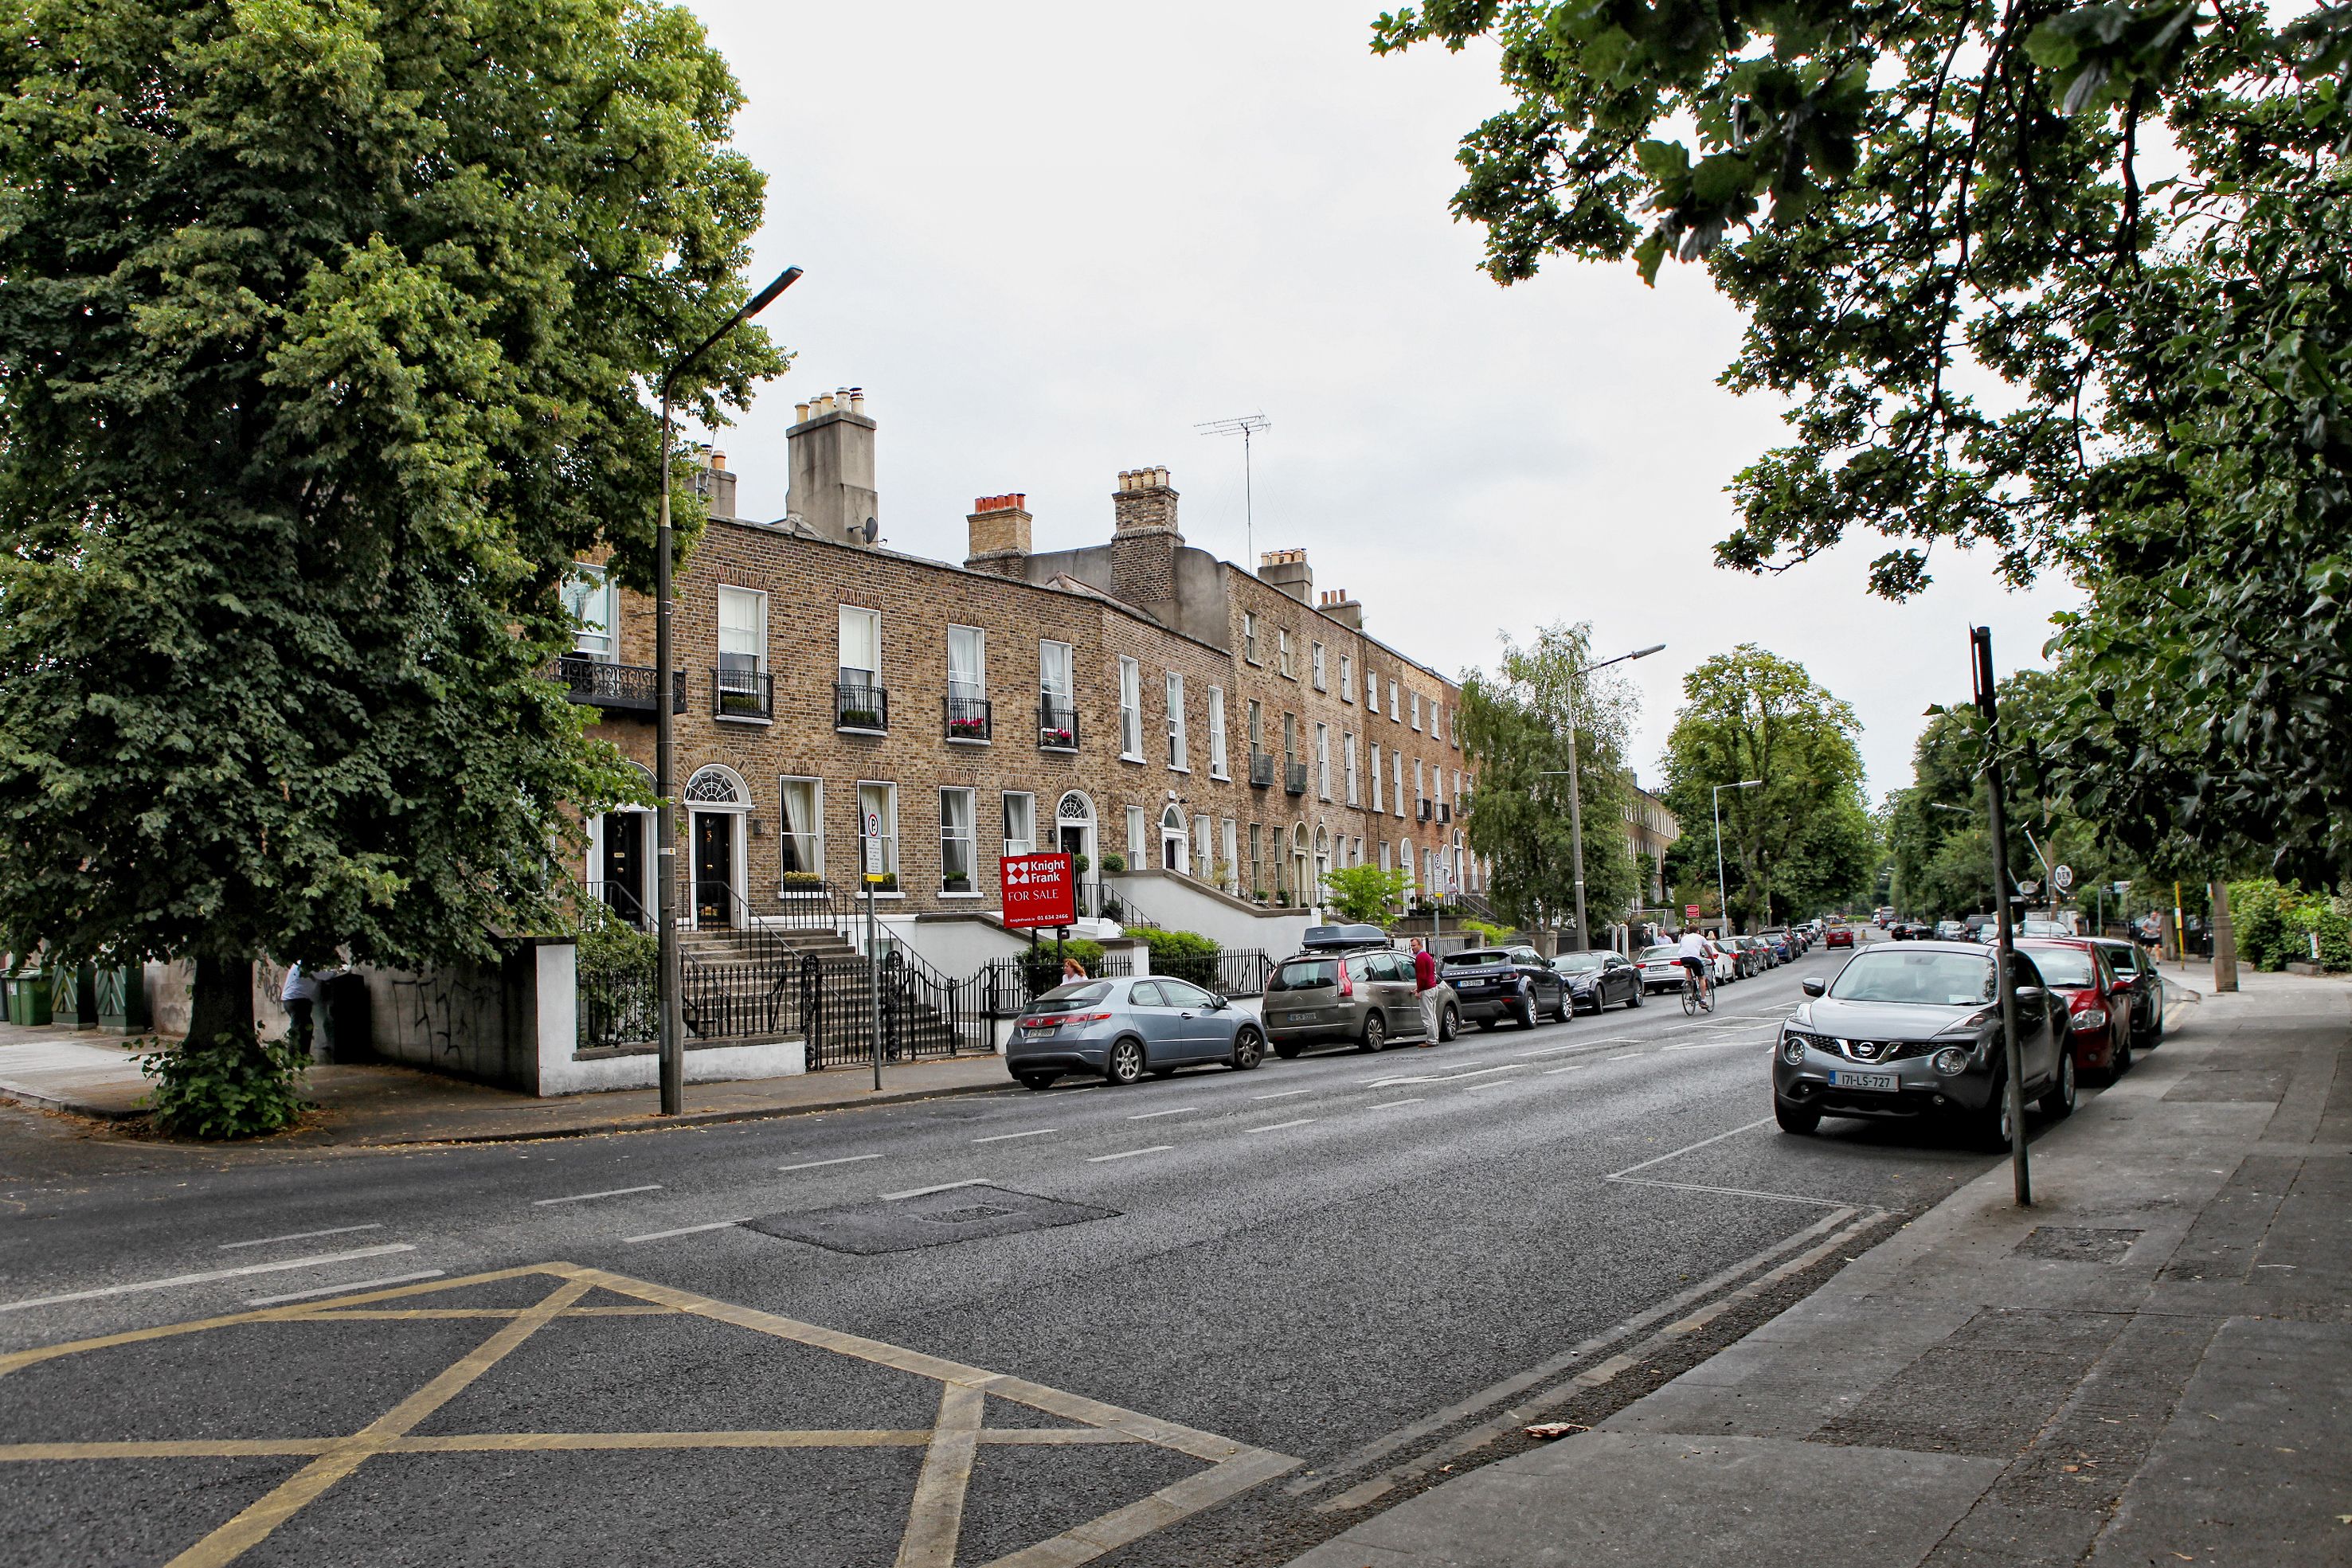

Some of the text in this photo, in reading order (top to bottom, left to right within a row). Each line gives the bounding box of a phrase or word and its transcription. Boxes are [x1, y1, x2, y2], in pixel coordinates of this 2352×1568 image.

[1031, 860, 1065, 872] Knight
[1031, 872, 1060, 883] Frank
[2057, 871, 2071, 880] DEN
[1008, 890, 1059, 901] FOR SALE
[1842, 1075, 1890, 1087] 171-LS-727
